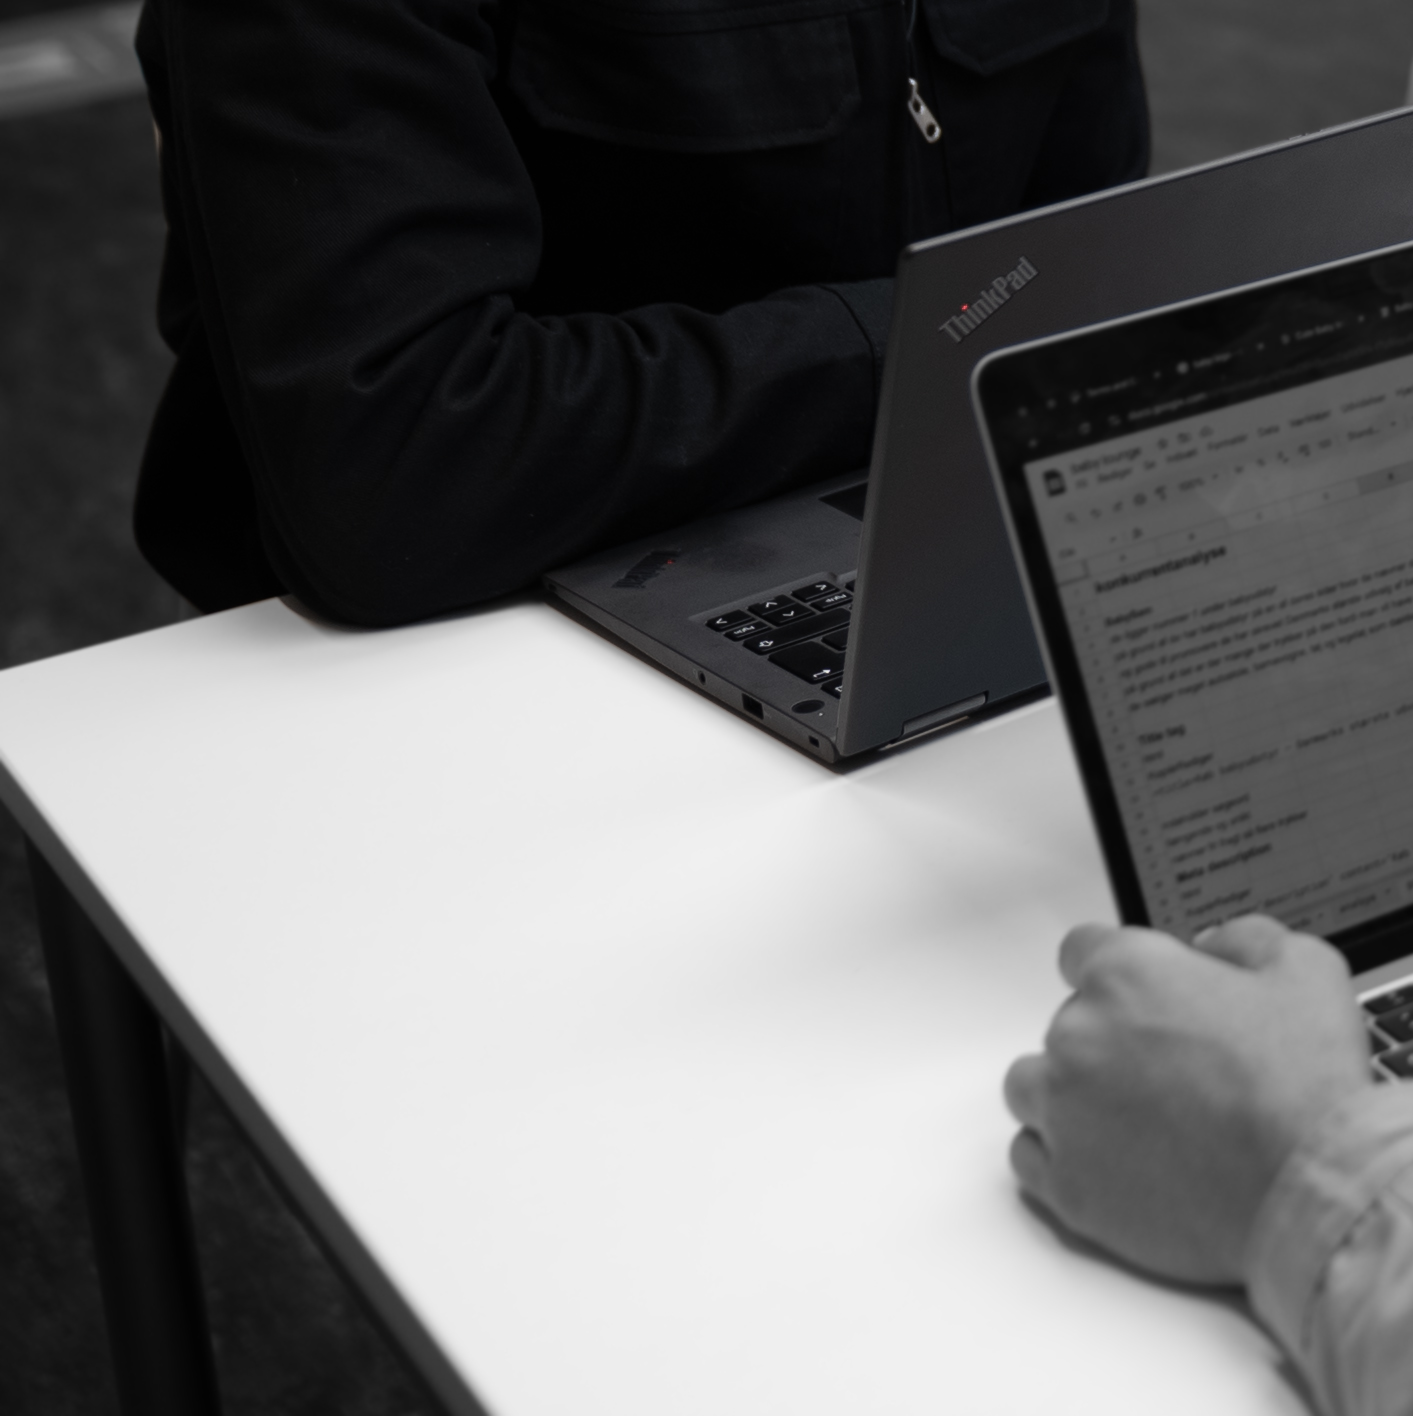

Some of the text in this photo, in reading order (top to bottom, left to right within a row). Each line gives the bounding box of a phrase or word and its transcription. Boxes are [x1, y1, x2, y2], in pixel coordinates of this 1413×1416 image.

[937, 254, 1040, 343] ThinkPad
[1094, 545, 1227, 594] konkurrentanalyse
[1136, 723, 1187, 747] Title tag
[1206, 842, 1273, 873] description
